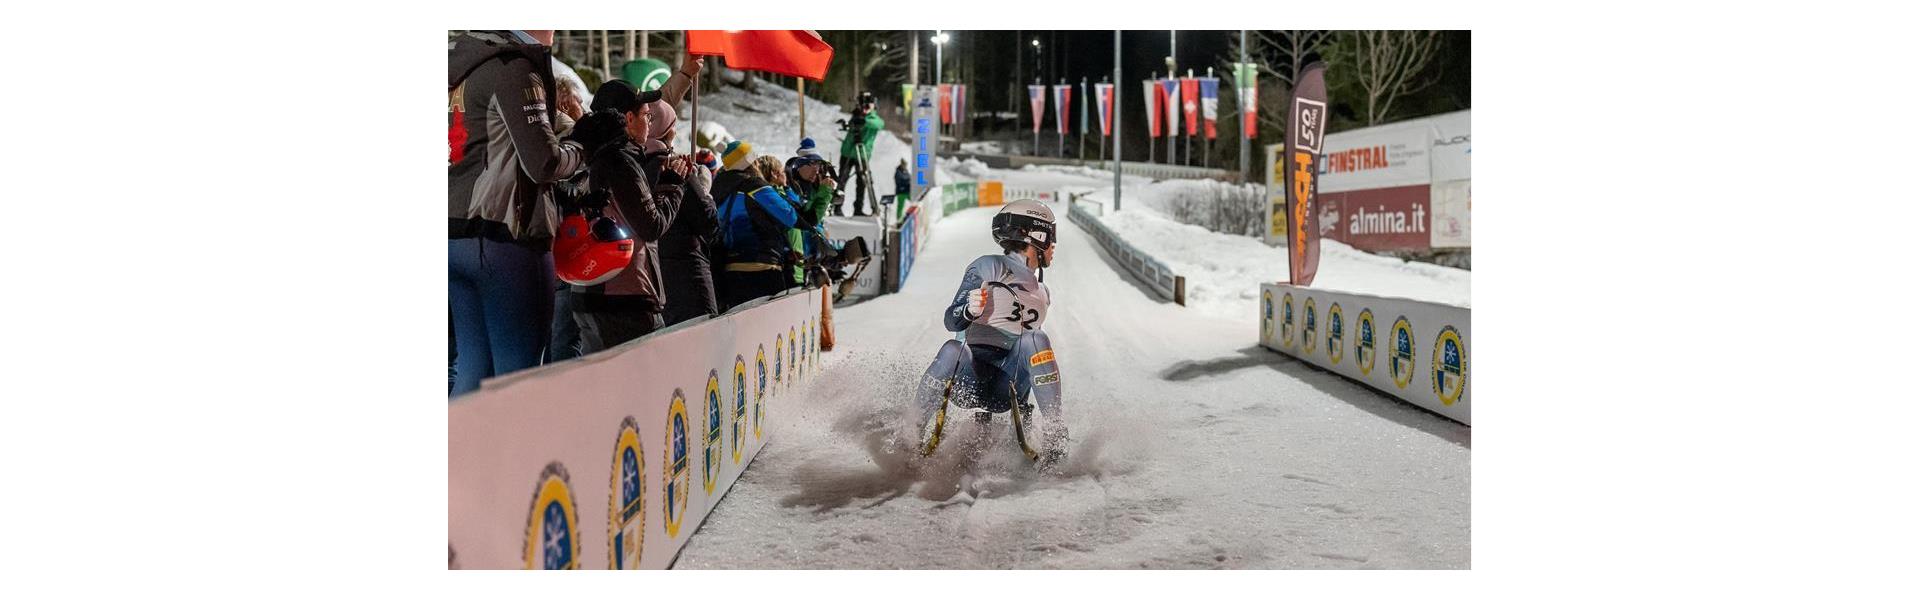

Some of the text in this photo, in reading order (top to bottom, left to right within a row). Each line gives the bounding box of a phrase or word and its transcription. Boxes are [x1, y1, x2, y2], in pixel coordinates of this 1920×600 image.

[1302, 109, 1314, 147] 50
[1310, 108, 1319, 129] YEARS
[917, 118, 930, 185] ZIEL
[1327, 144, 1389, 174] FINSTRAL
[1350, 203, 1426, 235] almina.it
[1006, 301, 1039, 330] 32
